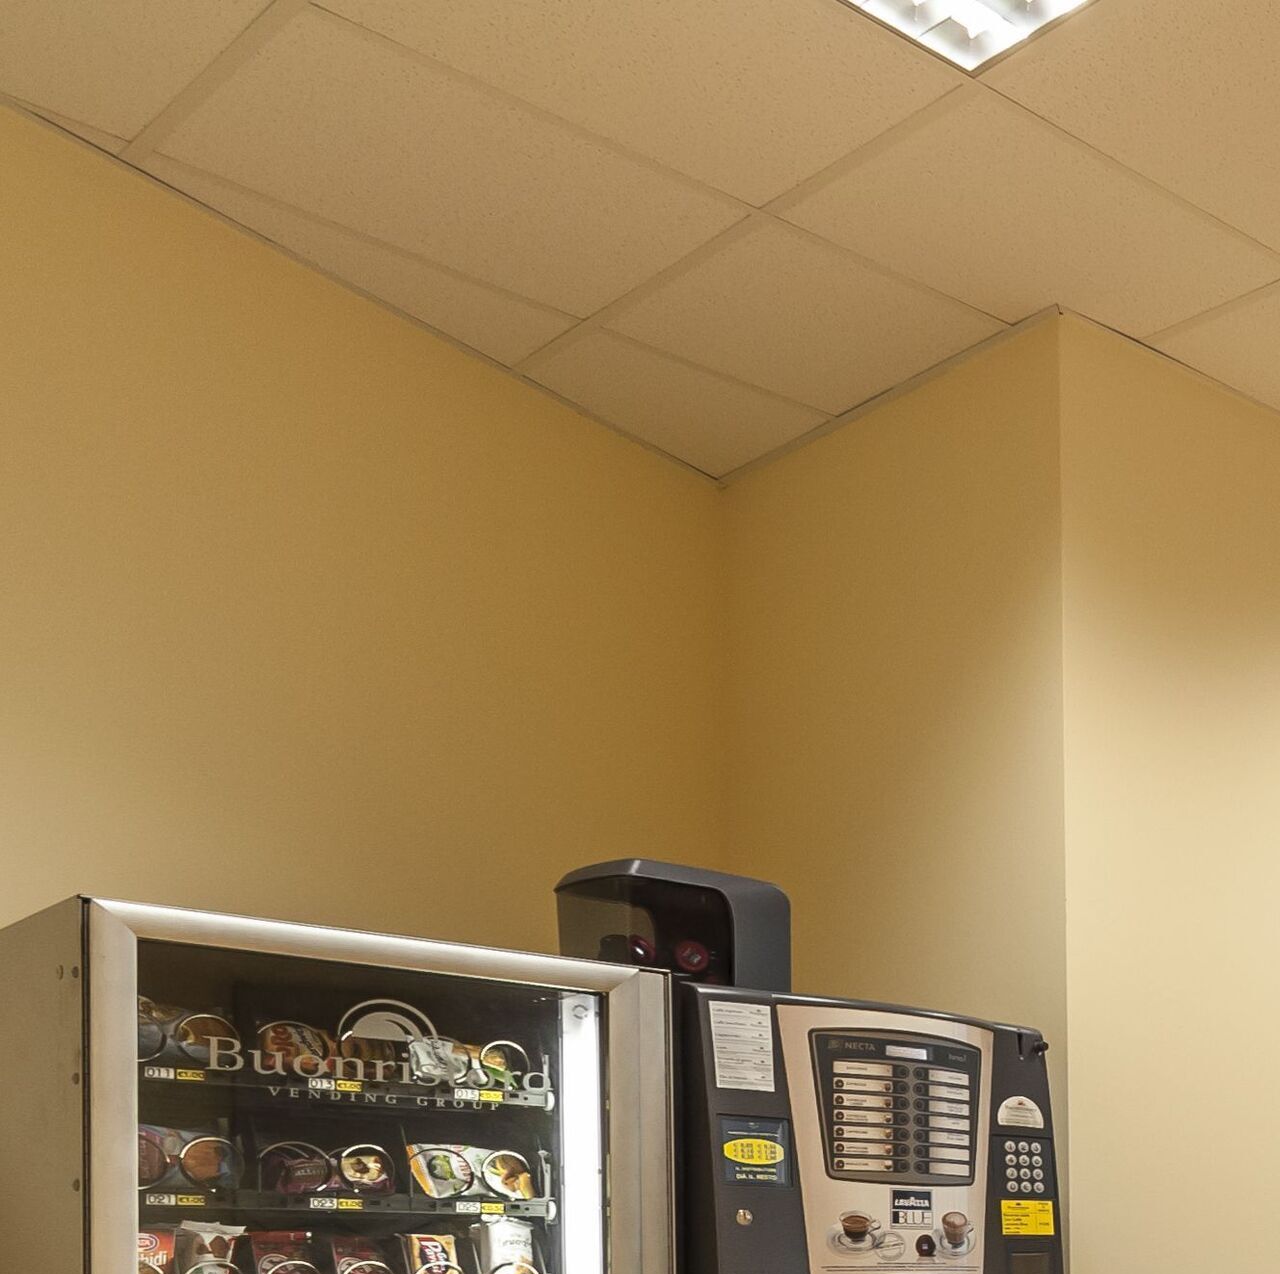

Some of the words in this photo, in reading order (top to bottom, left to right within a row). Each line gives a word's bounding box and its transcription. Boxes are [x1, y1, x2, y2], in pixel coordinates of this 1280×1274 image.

[845, 1042, 876, 1051] NECTA
[268, 1087, 397, 1105] VENDING
[417, 1097, 499, 1111] GROUP
